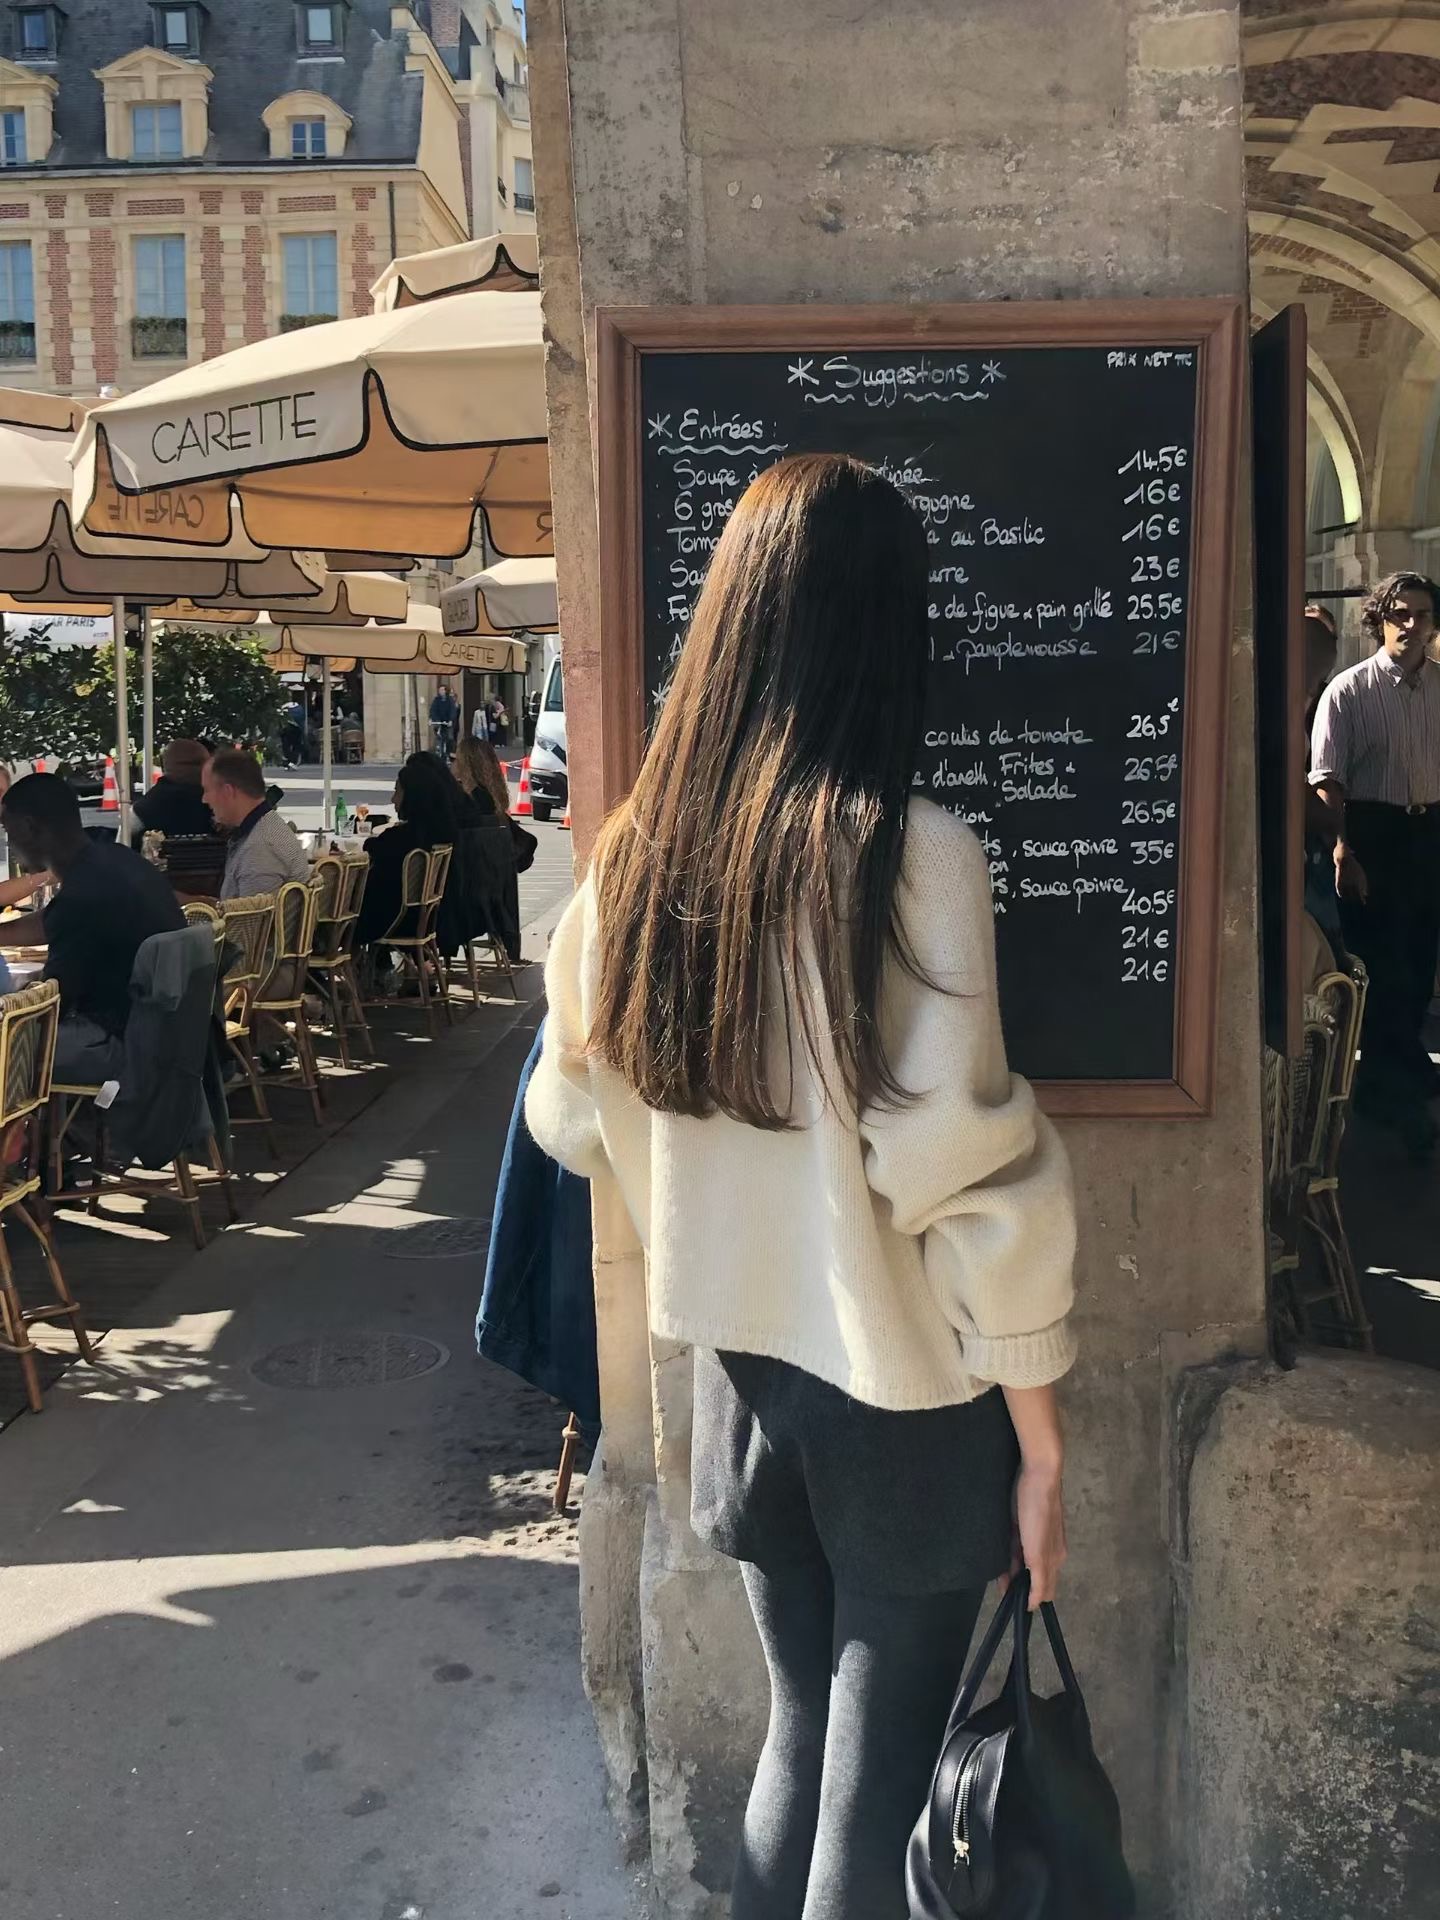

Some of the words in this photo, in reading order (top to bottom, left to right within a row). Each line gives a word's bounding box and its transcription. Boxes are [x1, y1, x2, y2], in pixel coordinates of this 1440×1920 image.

[1107, 351, 1137, 368] PRIX
[1143, 351, 1173, 367] NET
[823, 356, 970, 408] Suggestions
[152, 391, 316, 464] CARETTE
[673, 459, 740, 495] Soupe
[1123, 479, 1181, 505] 16€
[674, 491, 692, 521] 6
[980, 517, 1046, 546] Basilic
[1122, 513, 1180, 541] 16€
[1130, 555, 1180, 582] 23€
[944, 594, 968, 619] de
[968, 591, 1020, 634] figue
[1036, 600, 1066, 629] pain
[1069, 586, 1113, 632] grillé
[65, 616, 96, 632] PARIS
[441, 641, 495, 664] CARETTE
[956, 631, 1098, 676] pamplemousse
[1132, 630, 1181, 654] 21€
[924, 723, 981, 747] coulis
[988, 719, 1014, 746] de
[1017, 717, 1094, 745] tomate
[999, 752, 1055, 776] Frites
[1001, 776, 1077, 802] Salade
[1022, 839, 1070, 857] sauce
[1070, 838, 1119, 869] poivre
[1130, 839, 1175, 865] 35€
[1072, 877, 1129, 914] poivre
[1121, 925, 1169, 949] 21€
[1121, 957, 1168, 982] 21€
